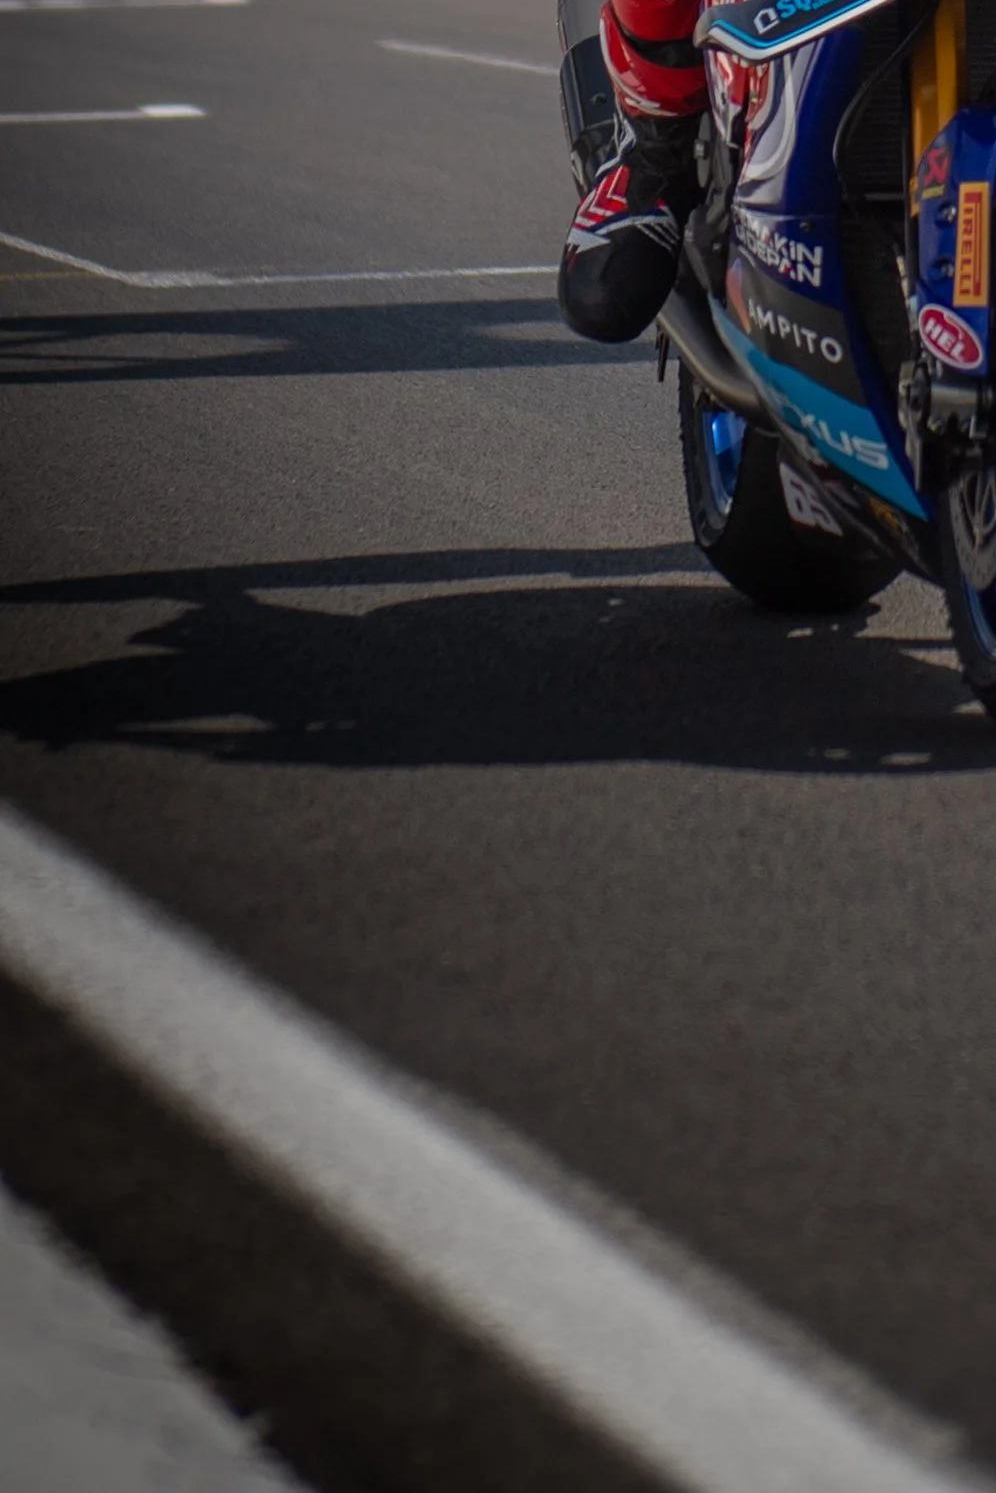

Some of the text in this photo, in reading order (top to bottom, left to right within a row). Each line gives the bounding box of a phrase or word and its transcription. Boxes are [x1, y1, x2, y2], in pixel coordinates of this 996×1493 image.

[958, 192, 983, 297] PIRELLI
[748, 298, 843, 363] AMPITO
[924, 317, 967, 363] HEL
